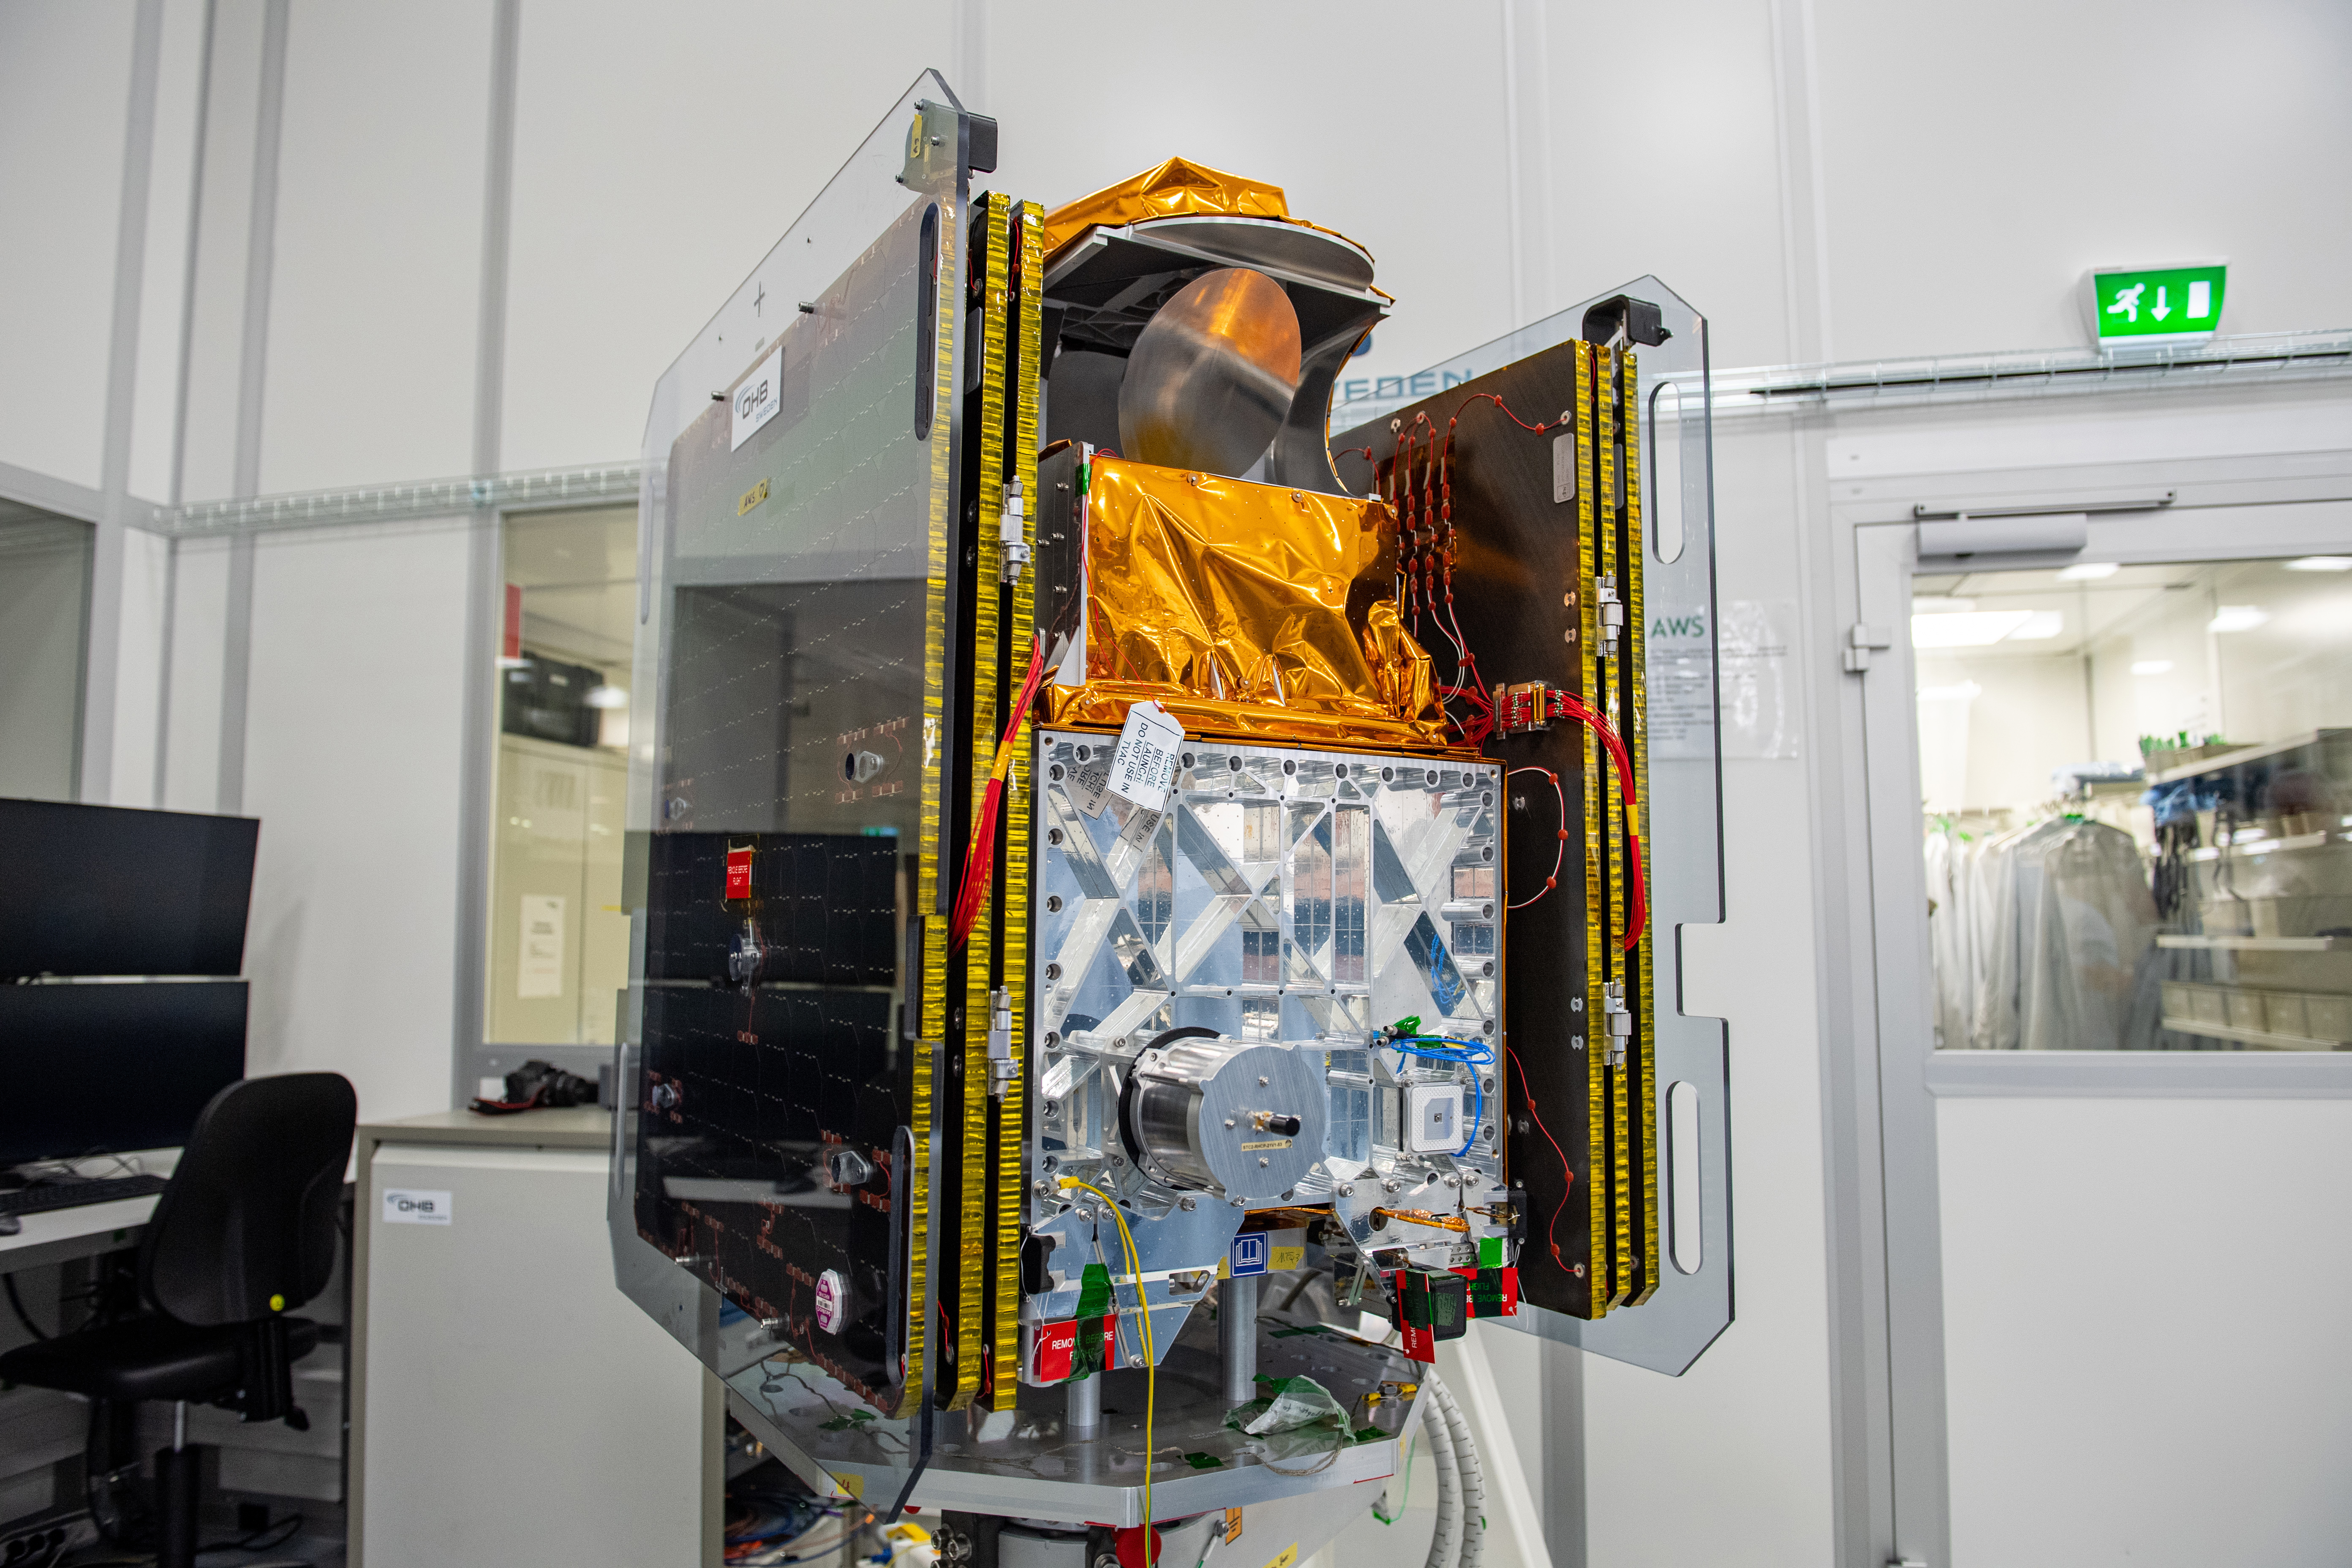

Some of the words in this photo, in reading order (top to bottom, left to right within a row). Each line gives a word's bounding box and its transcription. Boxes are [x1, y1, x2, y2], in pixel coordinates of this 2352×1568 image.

[1334, 368, 1473, 400] EDEN
[743, 379, 768, 419] OHB
[756, 397, 778, 423] SWEDEN
[1651, 614, 1705, 638] AWS
[1138, 722, 1148, 738] DO
[1117, 740, 1130, 767] TVAC
[1132, 738, 1142, 760] NOT
[1124, 761, 1136, 781] USE
[1135, 742, 1154, 784] LAUNCH!
[1147, 749, 1163, 788] BEFORE
[1157, 753, 1175, 793] REMOVE
[1122, 782, 1129, 793] IN
[1478, 1294, 1508, 1302] REMOVE
[1052, 1337, 1081, 1350] REMOVE
[1086, 1331, 1114, 1344] BEFORE
